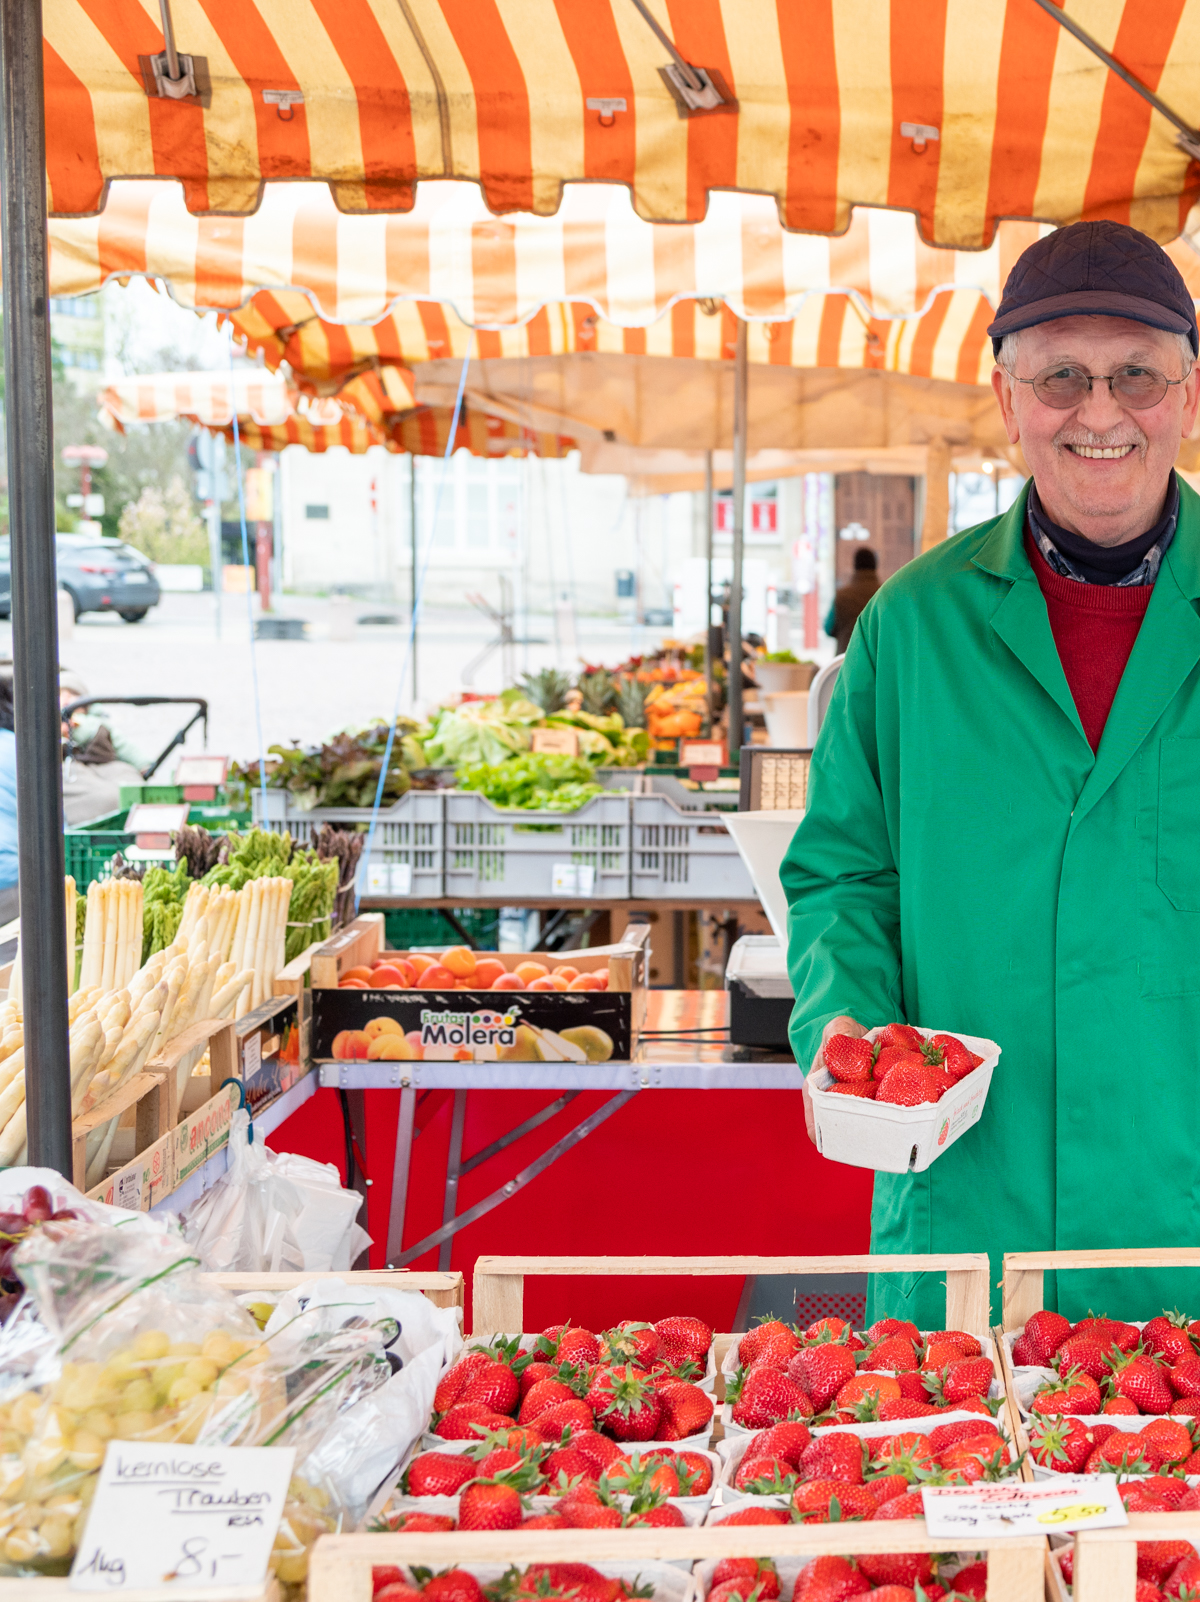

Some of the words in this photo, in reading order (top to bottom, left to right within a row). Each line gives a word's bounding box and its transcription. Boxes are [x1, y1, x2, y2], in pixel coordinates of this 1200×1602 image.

[423, 1012, 465, 1024] Frutas
[423, 1015, 514, 1045] Molera
[190, 1098, 231, 1151] ancona
[116, 1455, 227, 1478] kernlose
[158, 1487, 272, 1508] Trauben
[78, 1547, 126, 1586] 1kg
